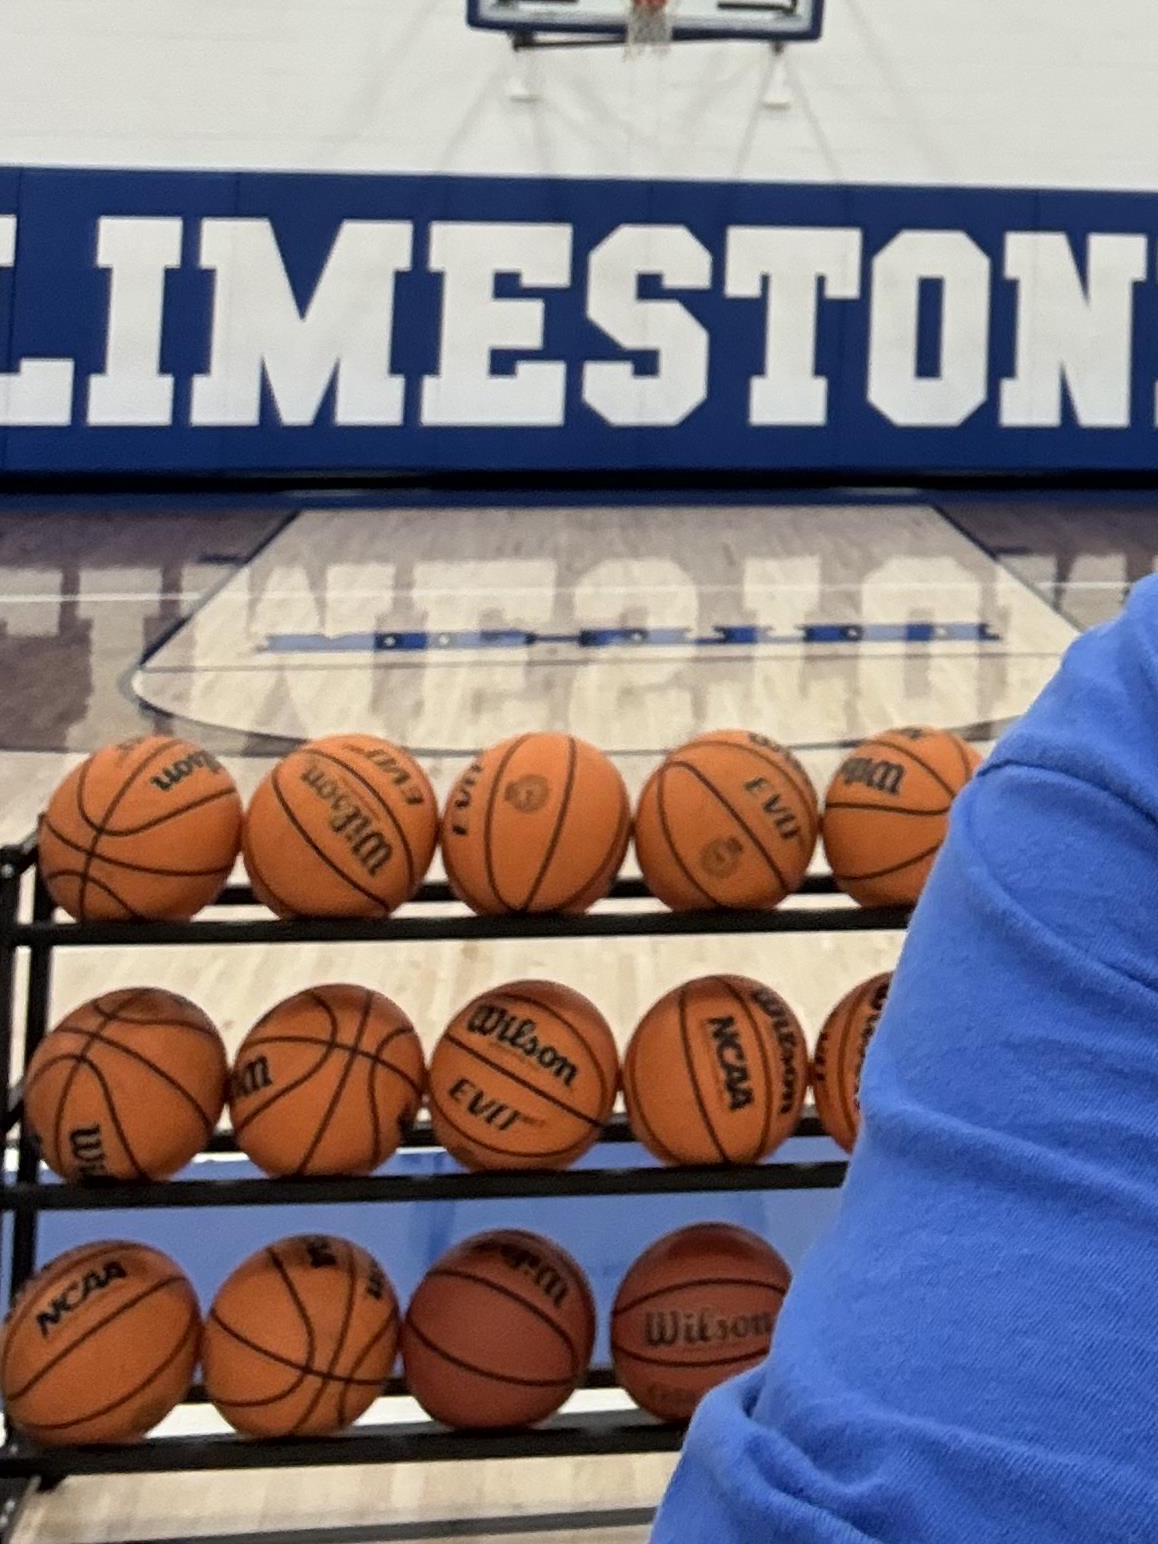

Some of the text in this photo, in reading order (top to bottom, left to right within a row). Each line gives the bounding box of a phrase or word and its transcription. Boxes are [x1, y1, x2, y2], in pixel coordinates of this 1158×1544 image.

[466, 1004, 577, 1087] Wilson
[706, 1015, 753, 1112] NCAA
[35, 1260, 128, 1337] NCAA
[644, 1308, 774, 1348] Wilson
